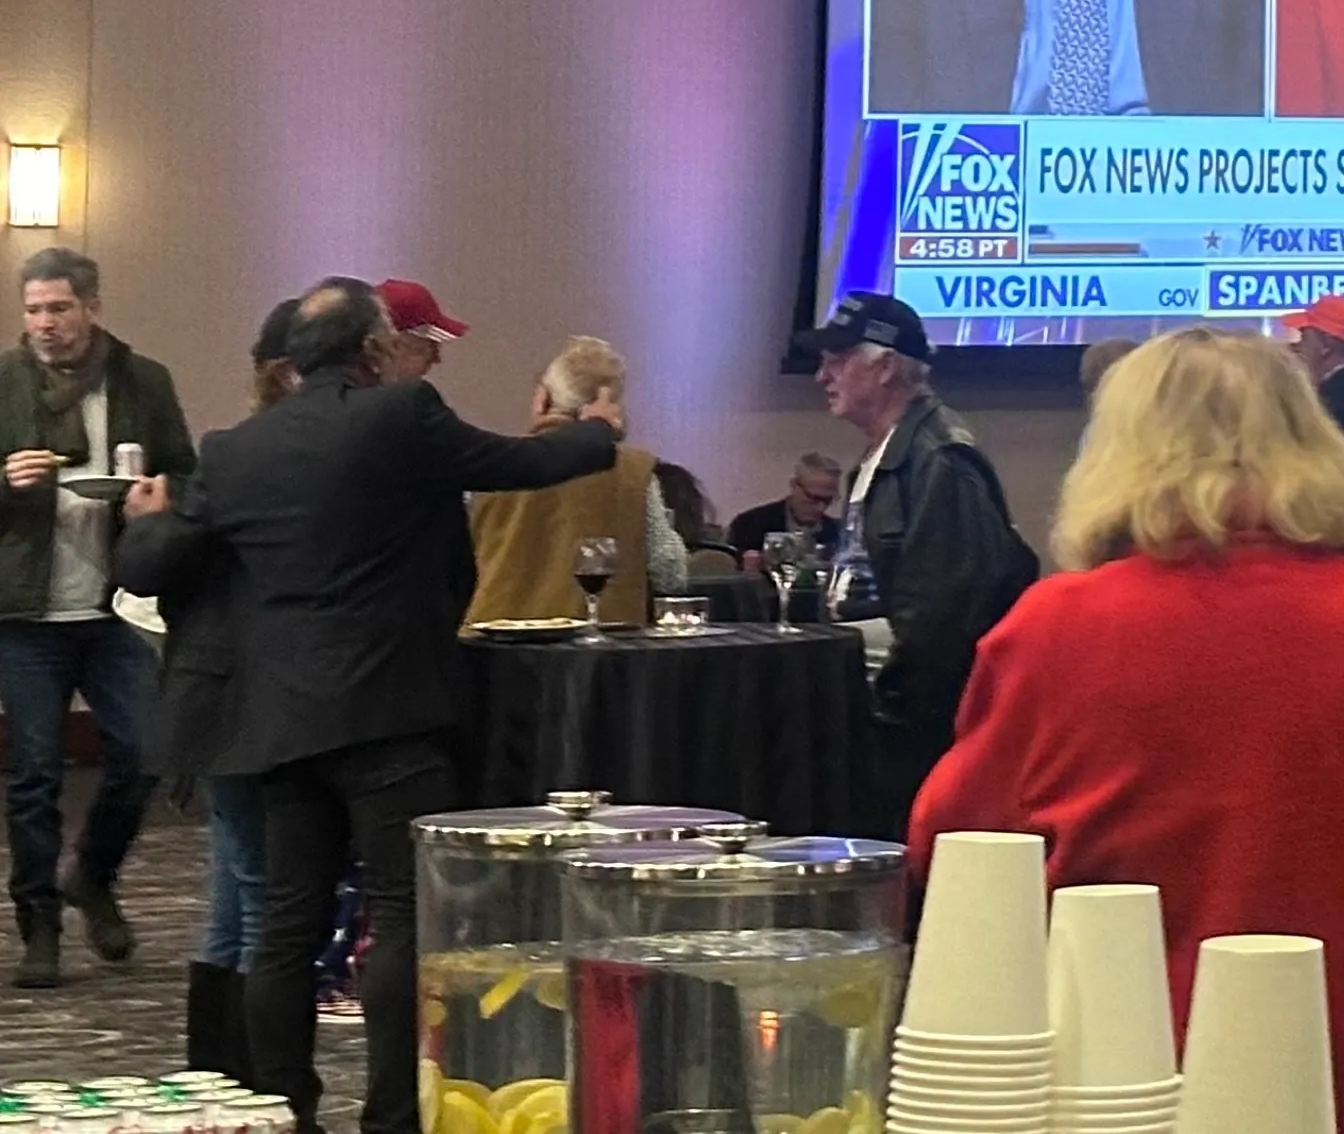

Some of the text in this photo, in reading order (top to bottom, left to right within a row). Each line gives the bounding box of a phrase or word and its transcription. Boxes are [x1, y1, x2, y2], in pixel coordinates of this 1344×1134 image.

[941, 154, 1016, 192] FOX
[1039, 147, 1097, 194] FOX
[1106, 147, 1189, 194] NEWS
[1198, 148, 1327, 194] PROJECTS
[917, 195, 1017, 230] NEWS
[909, 239, 1008, 258] 4:58 PT
[1256, 228, 1305, 252] FOX
[936, 275, 1199, 308] VIRGINIA GOV
